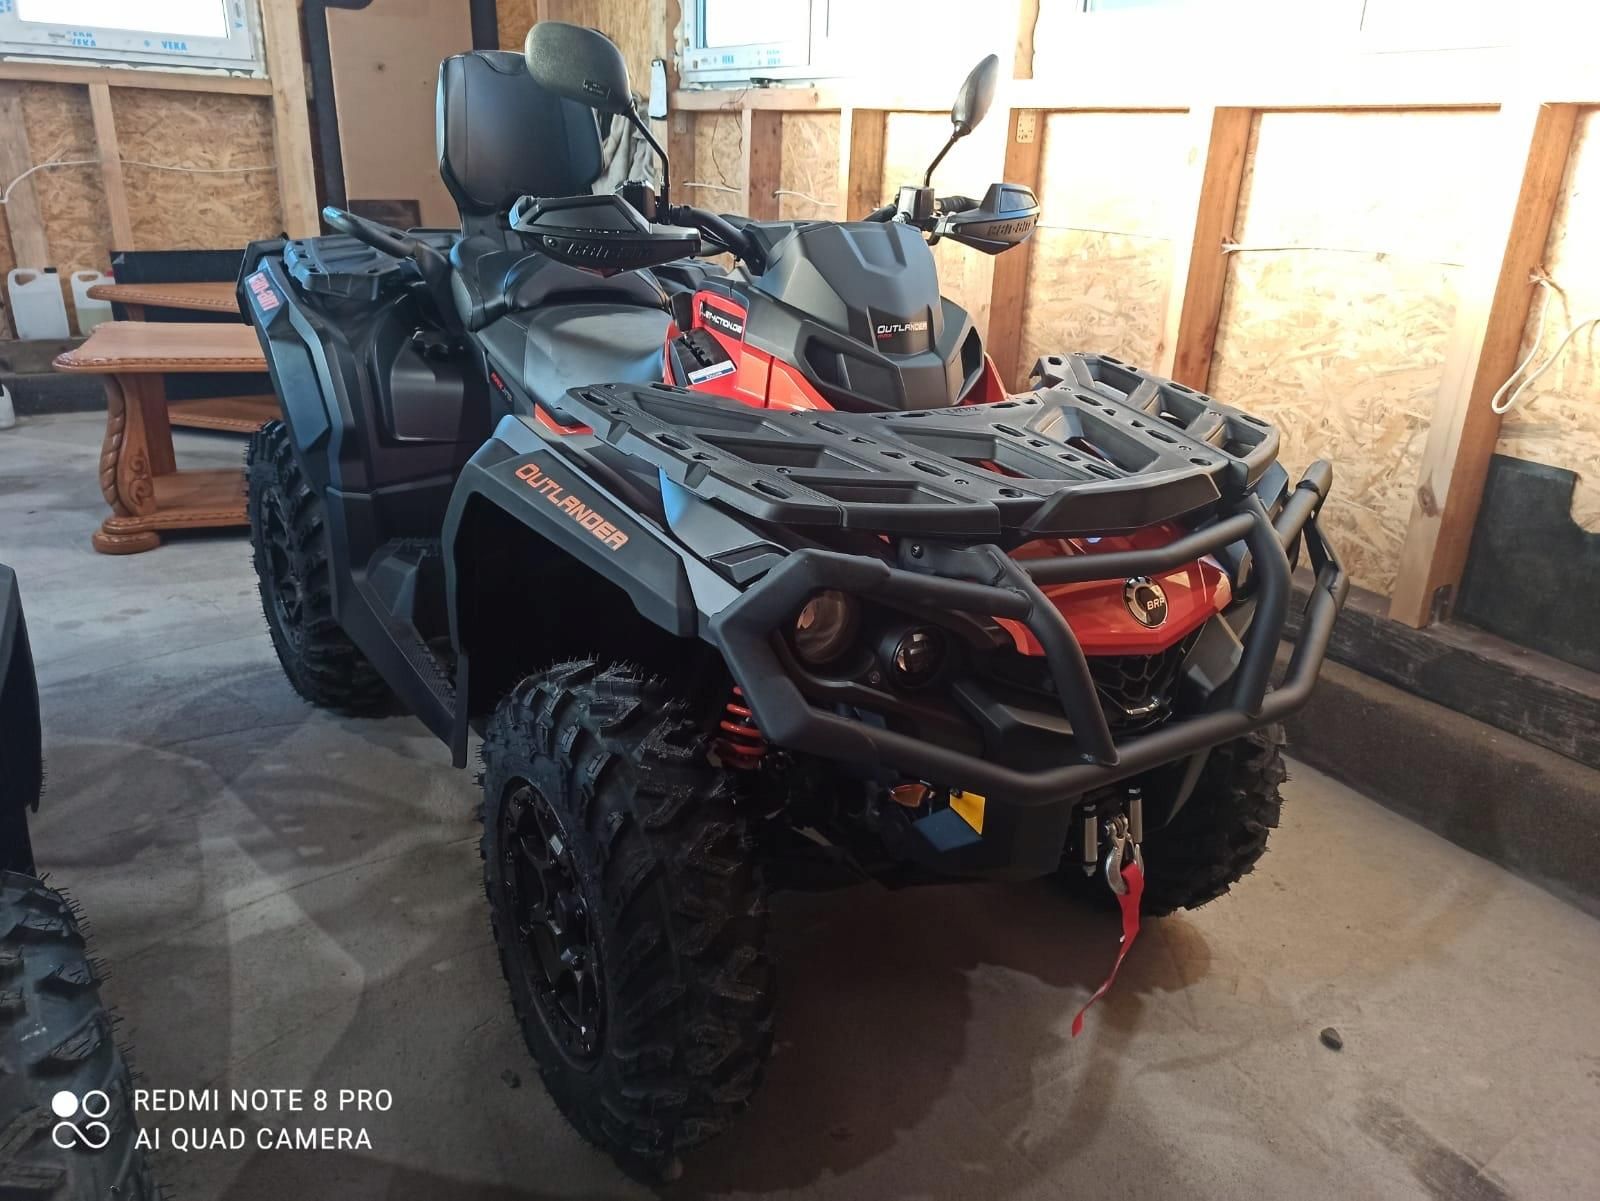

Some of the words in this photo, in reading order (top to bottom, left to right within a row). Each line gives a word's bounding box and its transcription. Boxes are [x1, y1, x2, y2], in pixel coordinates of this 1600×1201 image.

[161, 40, 187, 50] VEKA
[877, 321, 928, 334] OUTLANDER
[515, 463, 629, 551] OUTLANDER
[1147, 597, 1165, 610] BRP
